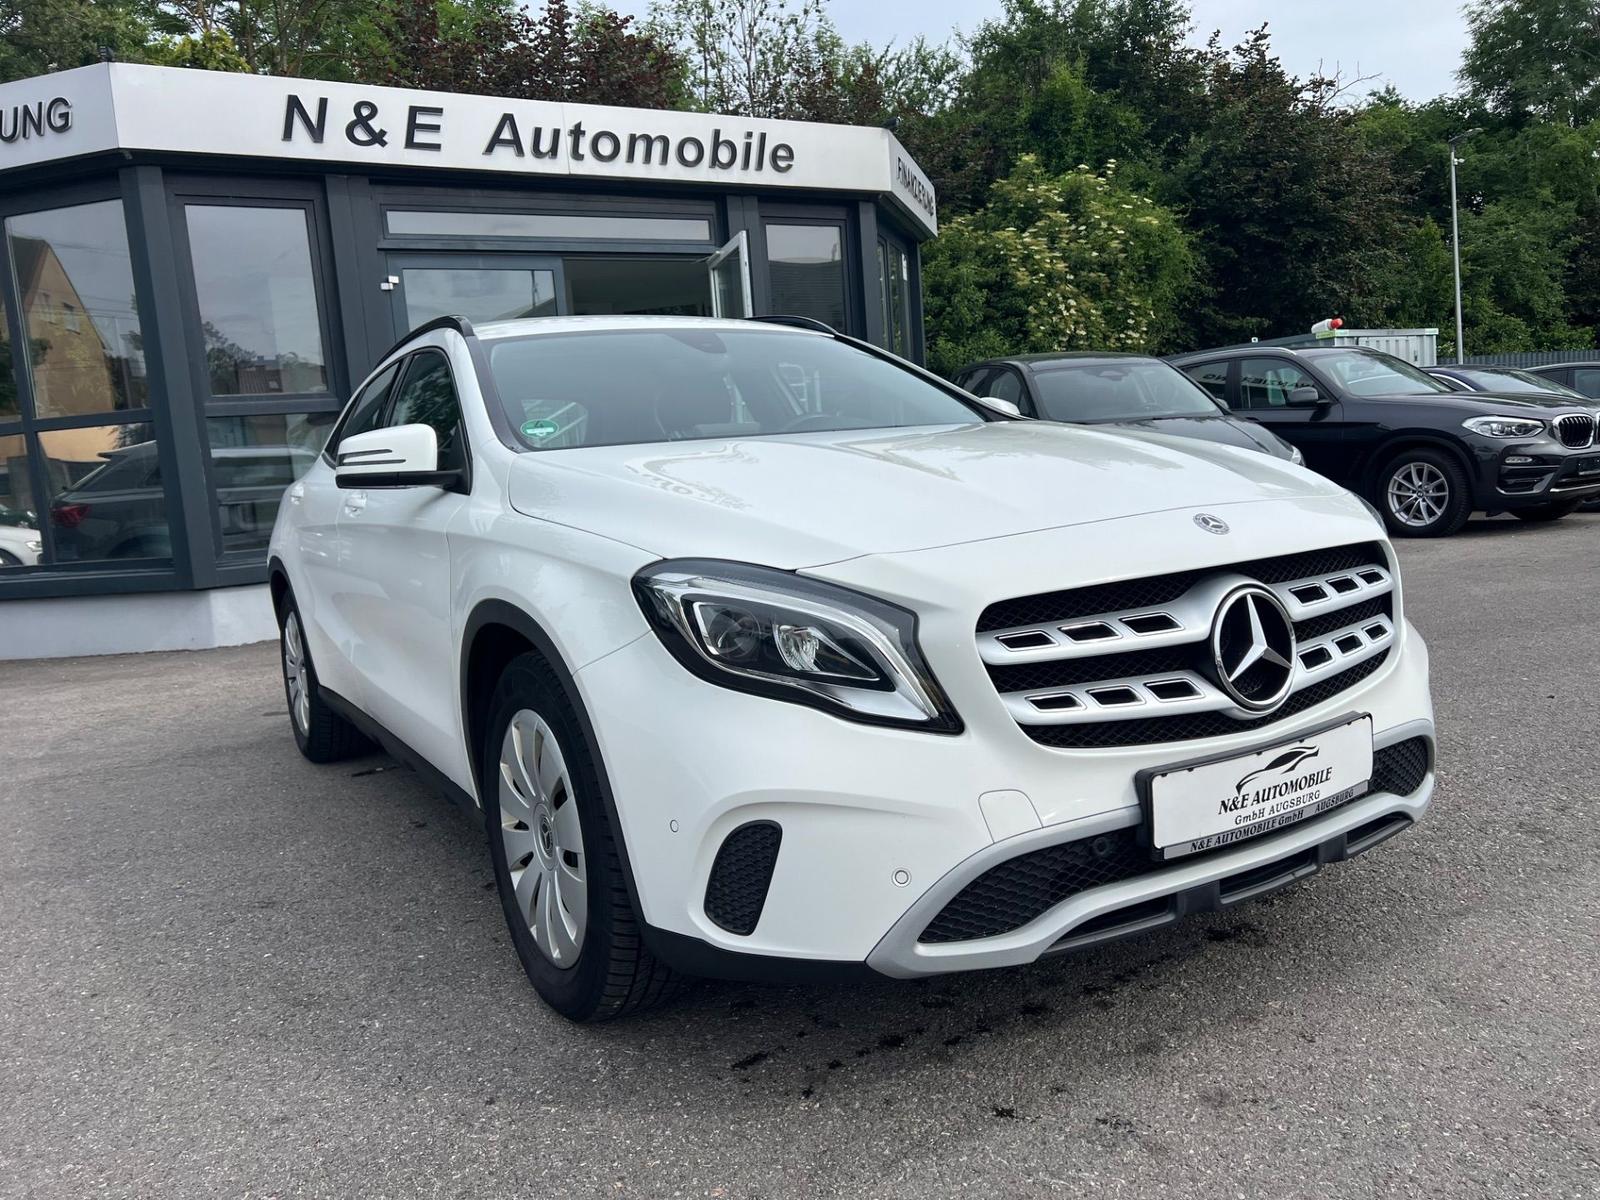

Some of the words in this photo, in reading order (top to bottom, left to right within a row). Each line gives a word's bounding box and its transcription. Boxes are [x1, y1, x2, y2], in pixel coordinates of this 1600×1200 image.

[482, 112, 796, 173] Automobile
[1217, 793, 1250, 815] N&E
[1250, 766, 1333, 807] AUTOMOBILE
[1234, 807, 1266, 825] GmbH
[1268, 789, 1321, 816] AUGSBURG
[1190, 837, 1212, 852] N&E
[1213, 819, 1278, 846] AUTOMOBILE
[1277, 809, 1304, 826] GmbH
[1314, 788, 1355, 813] AUGSBURG
